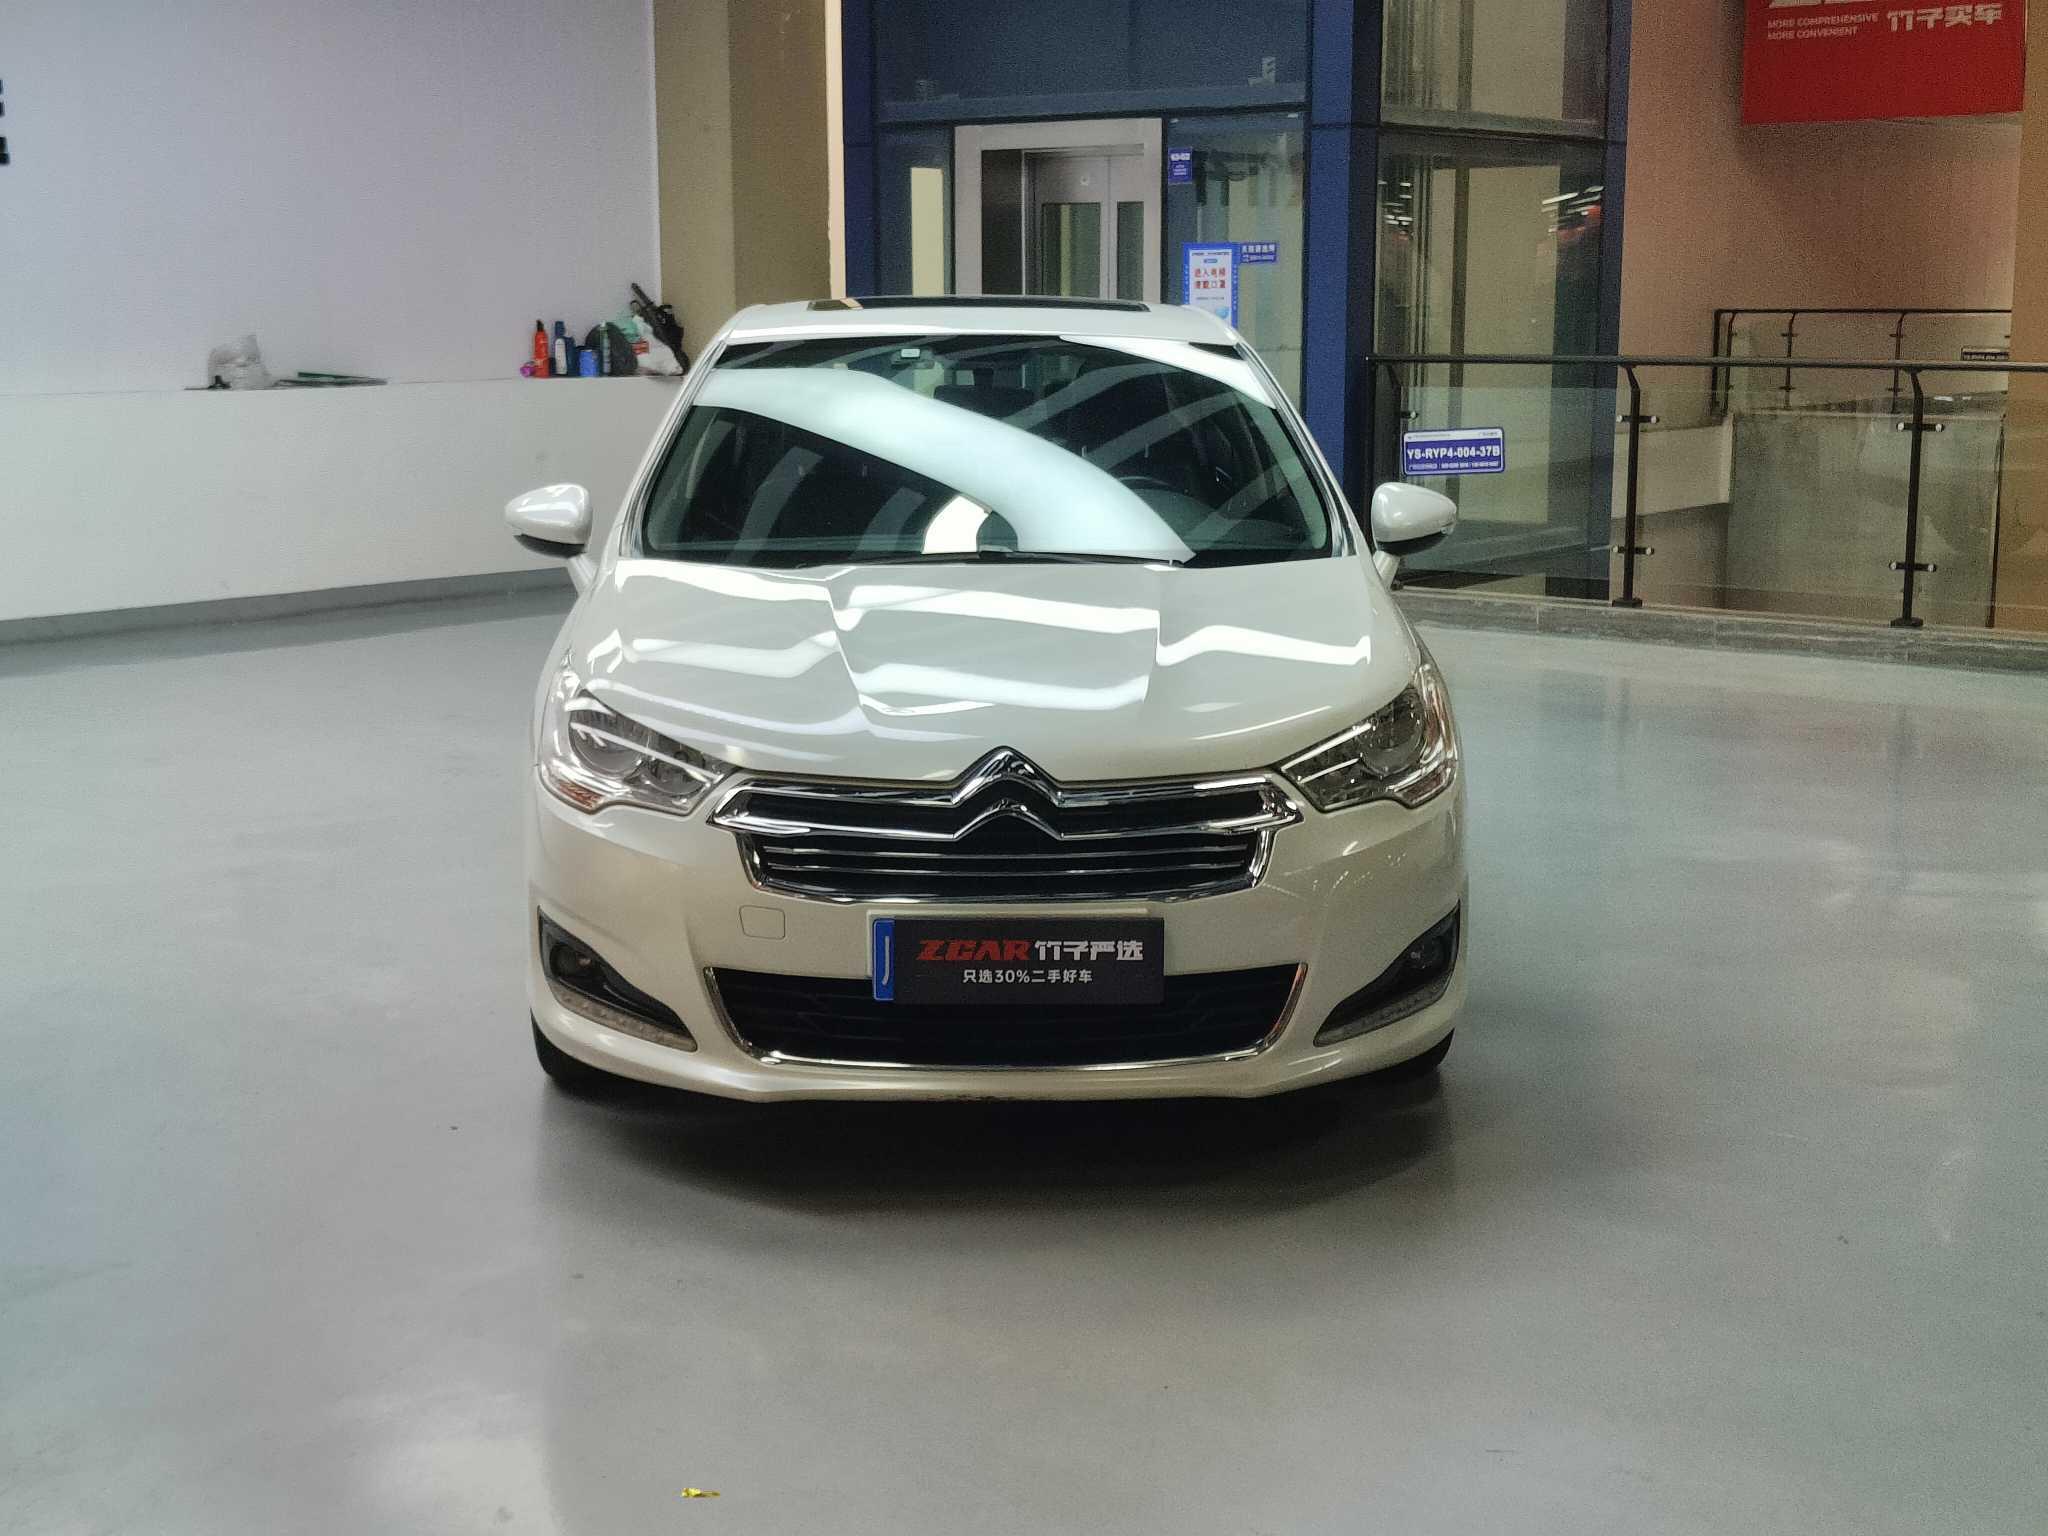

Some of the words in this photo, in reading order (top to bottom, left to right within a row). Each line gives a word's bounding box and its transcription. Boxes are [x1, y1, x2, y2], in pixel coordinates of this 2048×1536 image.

[1767, 18, 1795, 29] MORE
[1797, 13, 1879, 27] COMPREHENSIVE
[1887, 3, 2002, 31] 竹子买车
[1767, 30, 1795, 40] MORE
[915, 939, 1033, 961] ZCAR
[1034, 939, 1144, 961] 竹子严选
[962, 969, 1093, 984] 只选30%二手好车
